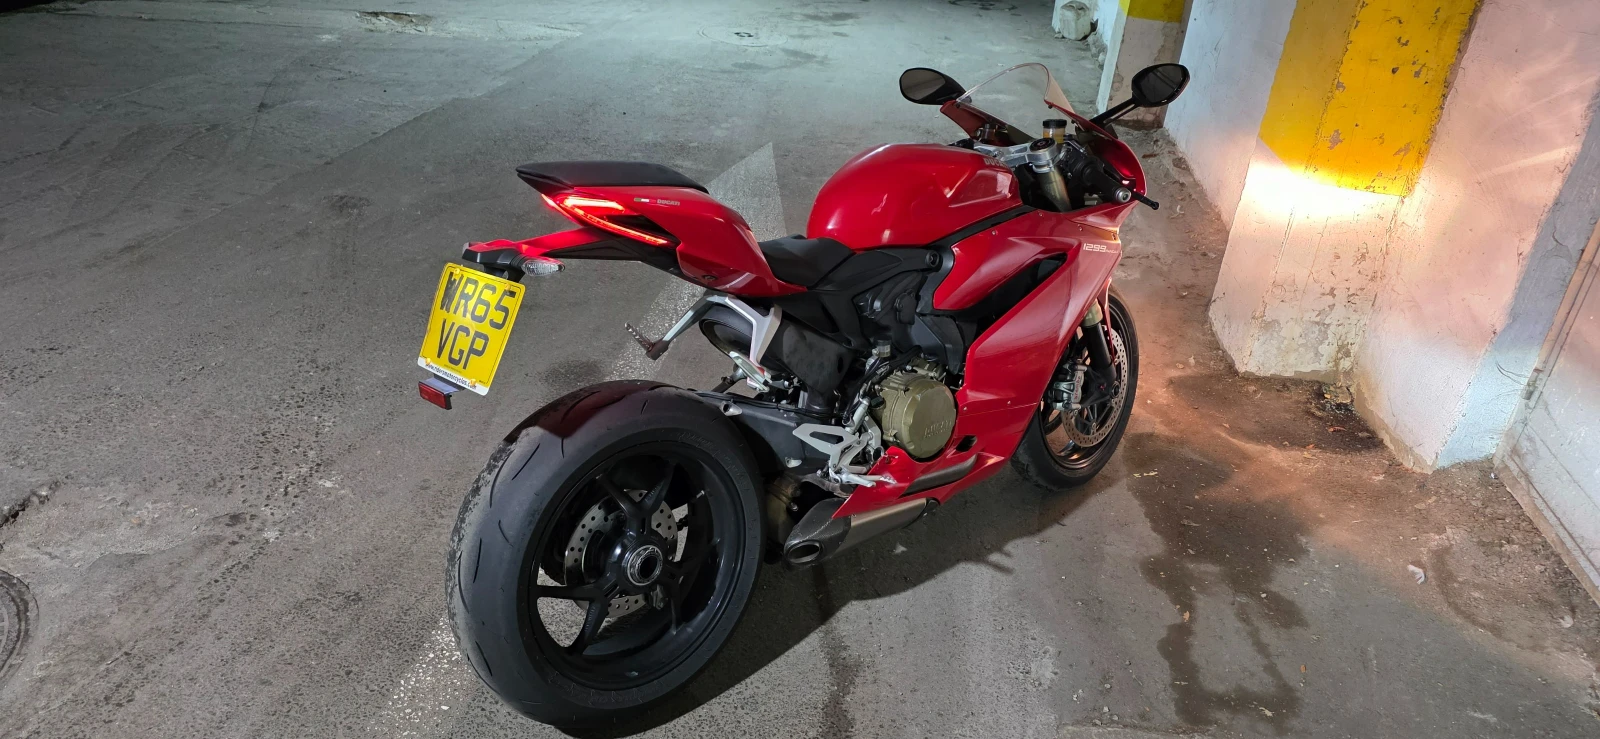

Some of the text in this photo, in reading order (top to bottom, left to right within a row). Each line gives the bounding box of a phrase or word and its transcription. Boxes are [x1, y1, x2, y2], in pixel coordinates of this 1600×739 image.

[657, 198, 680, 206] DUCATI
[1083, 243, 1107, 252] 1299
[440, 271, 516, 330] WR65
[437, 318, 489, 370] VGP
